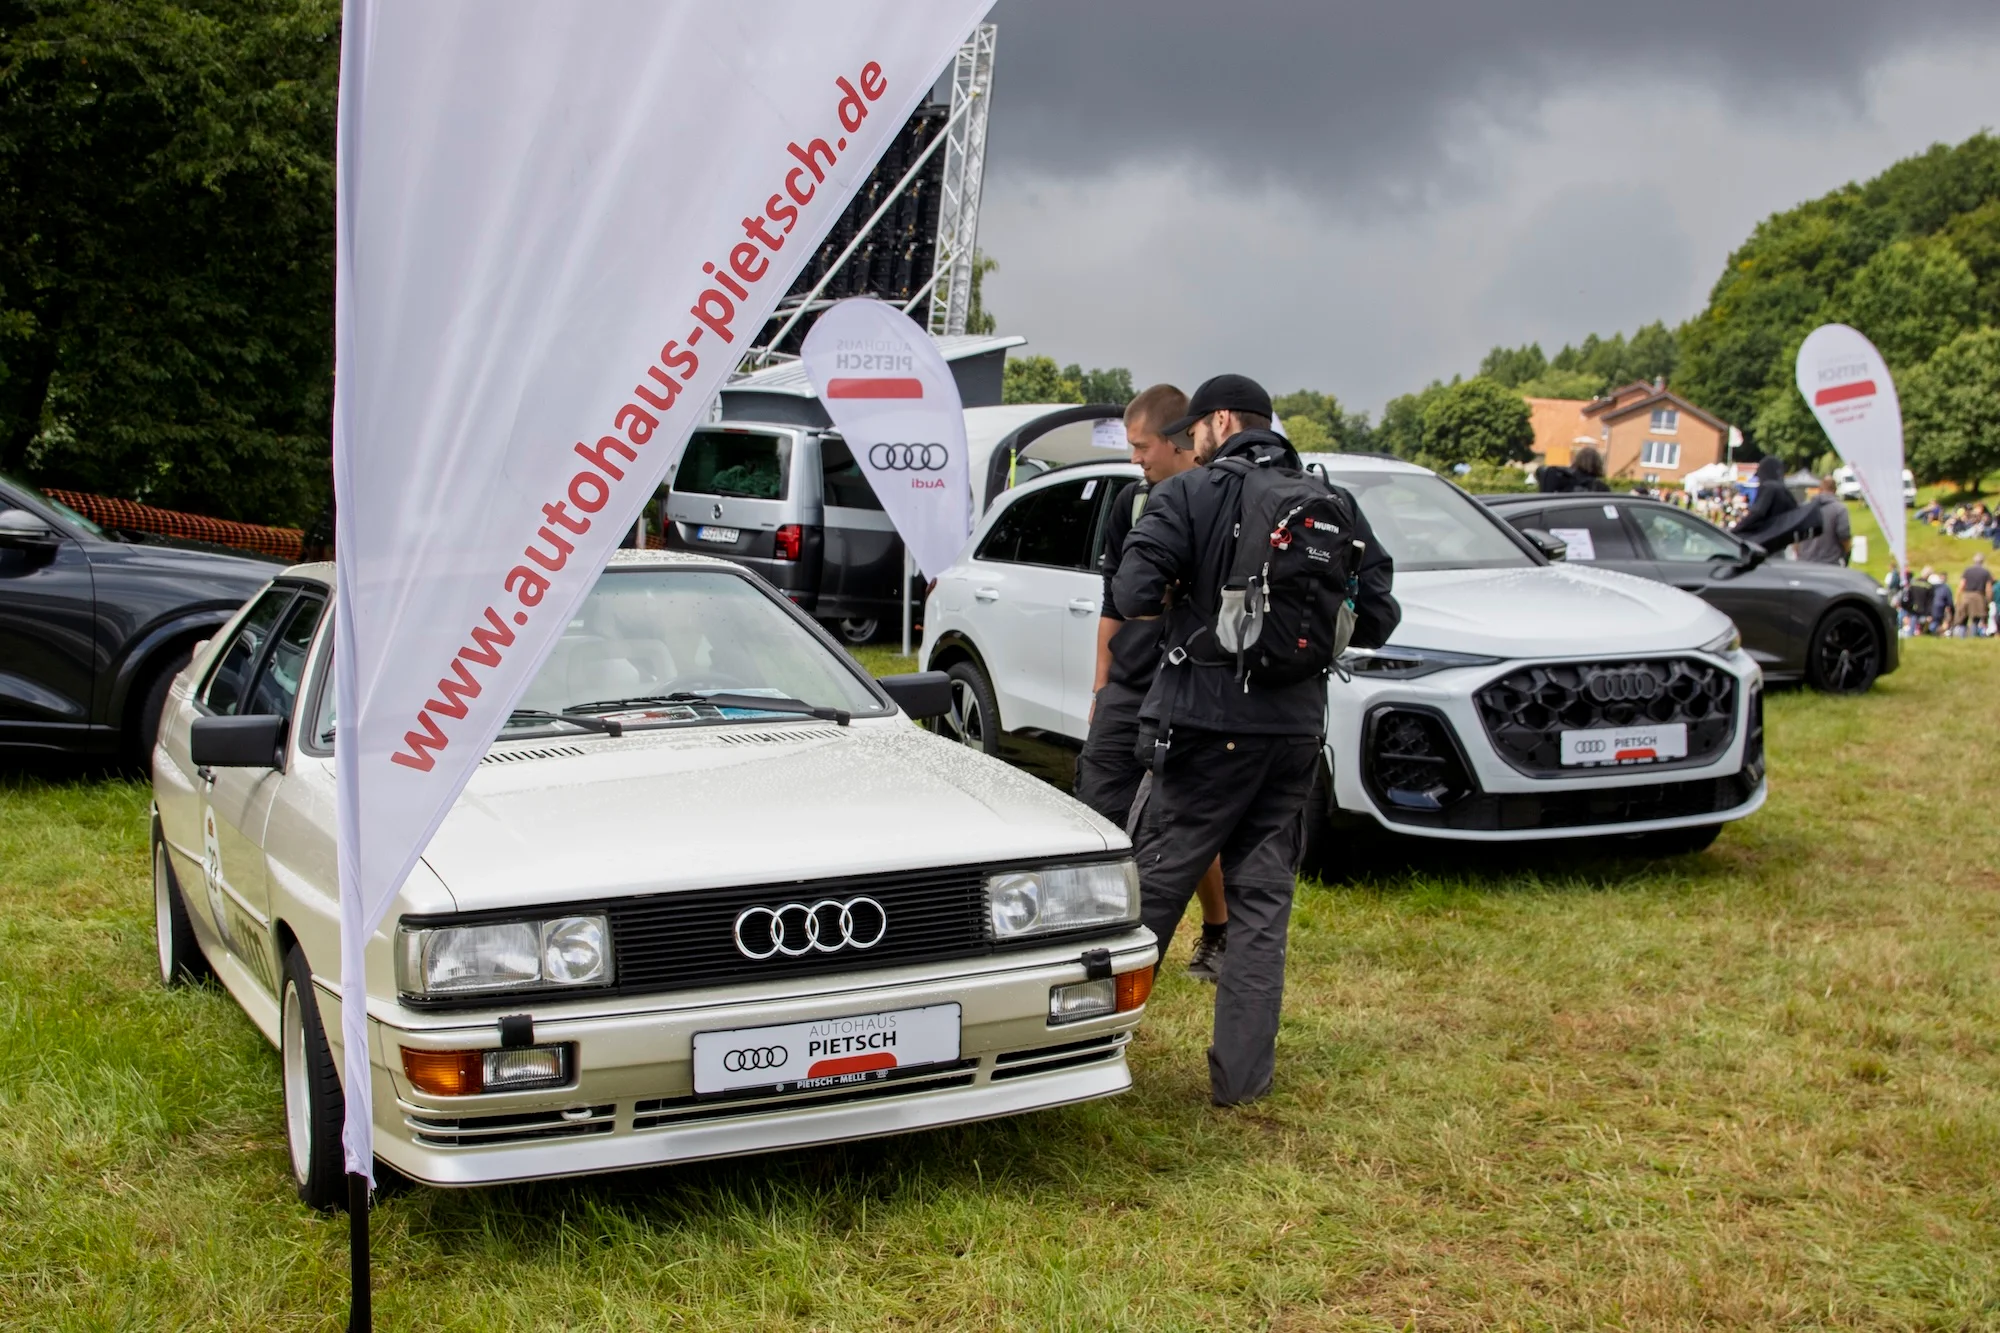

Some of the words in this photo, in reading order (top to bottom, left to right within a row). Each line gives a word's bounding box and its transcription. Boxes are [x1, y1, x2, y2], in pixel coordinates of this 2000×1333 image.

[391, 61, 888, 772] www.autohaus-pietsch.de
[1614, 736, 1657, 749] PIETSCH
[809, 1016, 896, 1037] AUTOHAUS
[809, 1030, 896, 1056] PIETSCH
[797, 1078, 833, 1089] PIETSCH
[840, 1073, 866, 1084] MELLE
